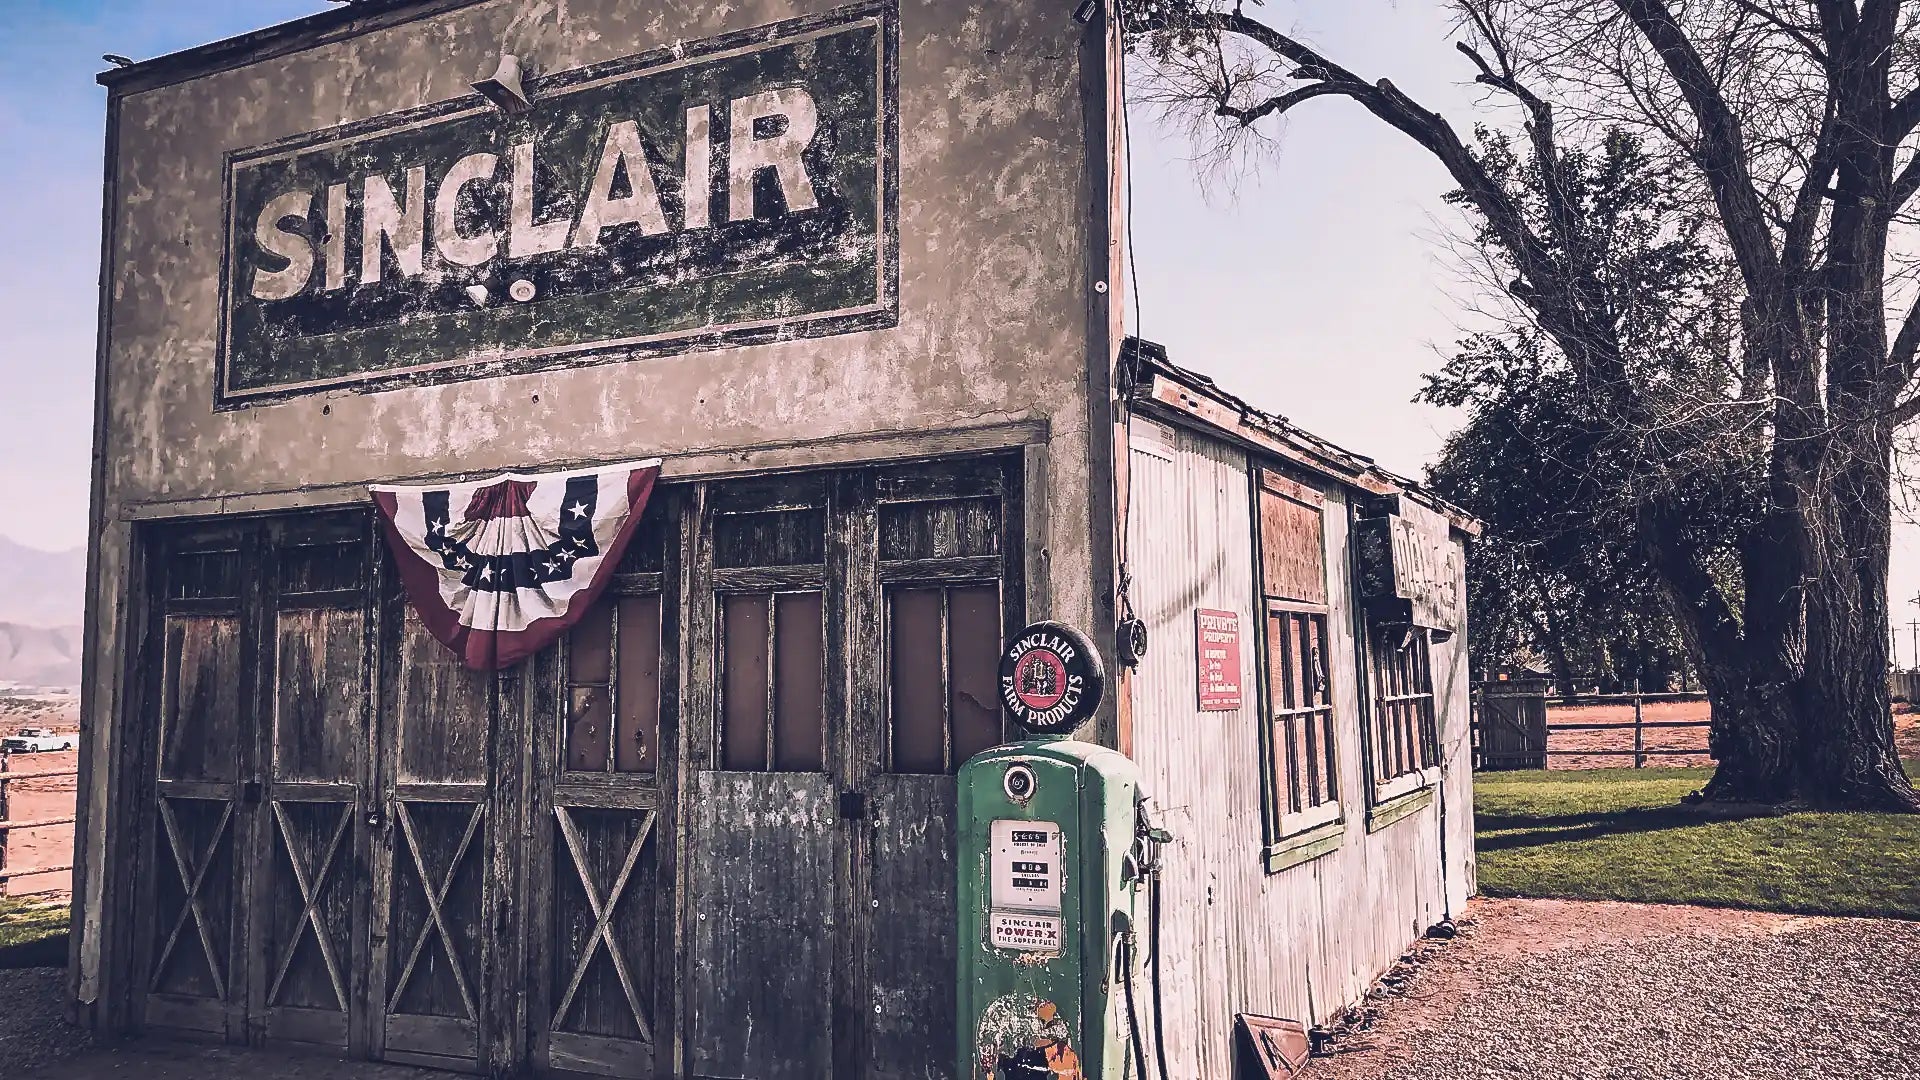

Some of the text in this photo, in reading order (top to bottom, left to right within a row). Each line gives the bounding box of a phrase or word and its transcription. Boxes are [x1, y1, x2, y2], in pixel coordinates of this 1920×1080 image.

[250, 86, 818, 302] SINCLAIR
[1200, 615, 1238, 632] PRIVATE
[1009, 633, 1075, 663] SINCLAIR
[1002, 674, 1083, 726] FARM PRODUCTS
[1001, 918, 1052, 929] SINCLAIR
[998, 935, 1011, 943] THE
[1013, 936, 1037, 945] SUPER
